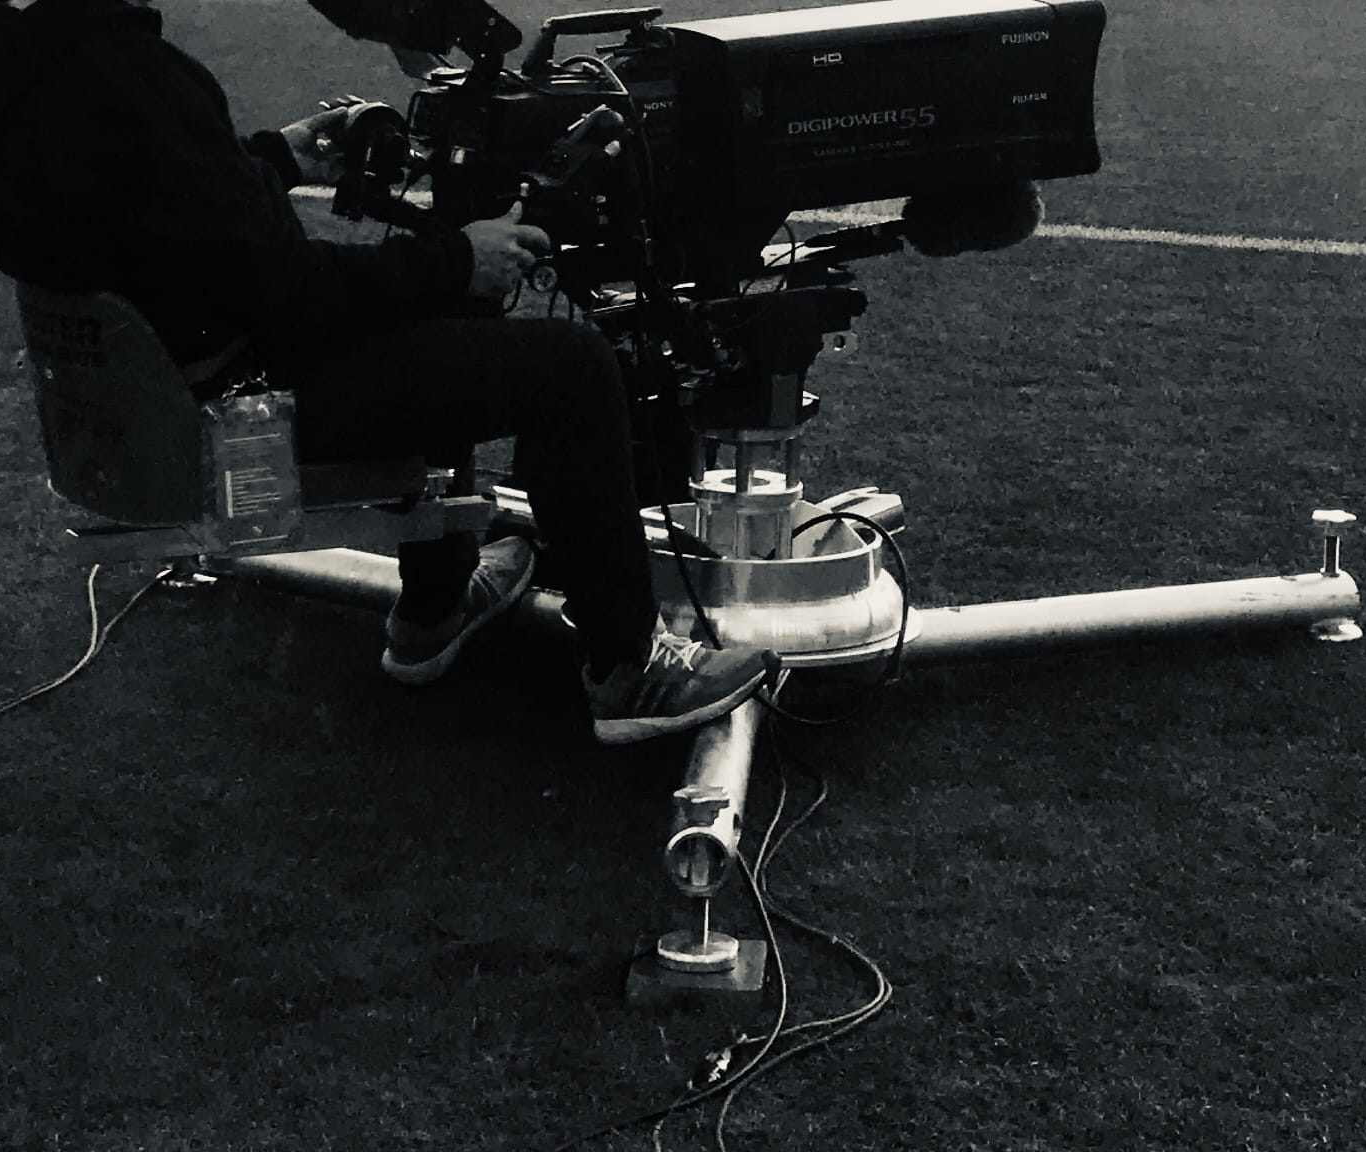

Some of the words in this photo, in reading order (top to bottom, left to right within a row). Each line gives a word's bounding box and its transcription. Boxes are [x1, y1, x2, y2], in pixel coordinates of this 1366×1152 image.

[1001, 30, 1050, 46] FUJINON
[813, 51, 843, 65] HD
[787, 109, 897, 136] DIGIPOWER
